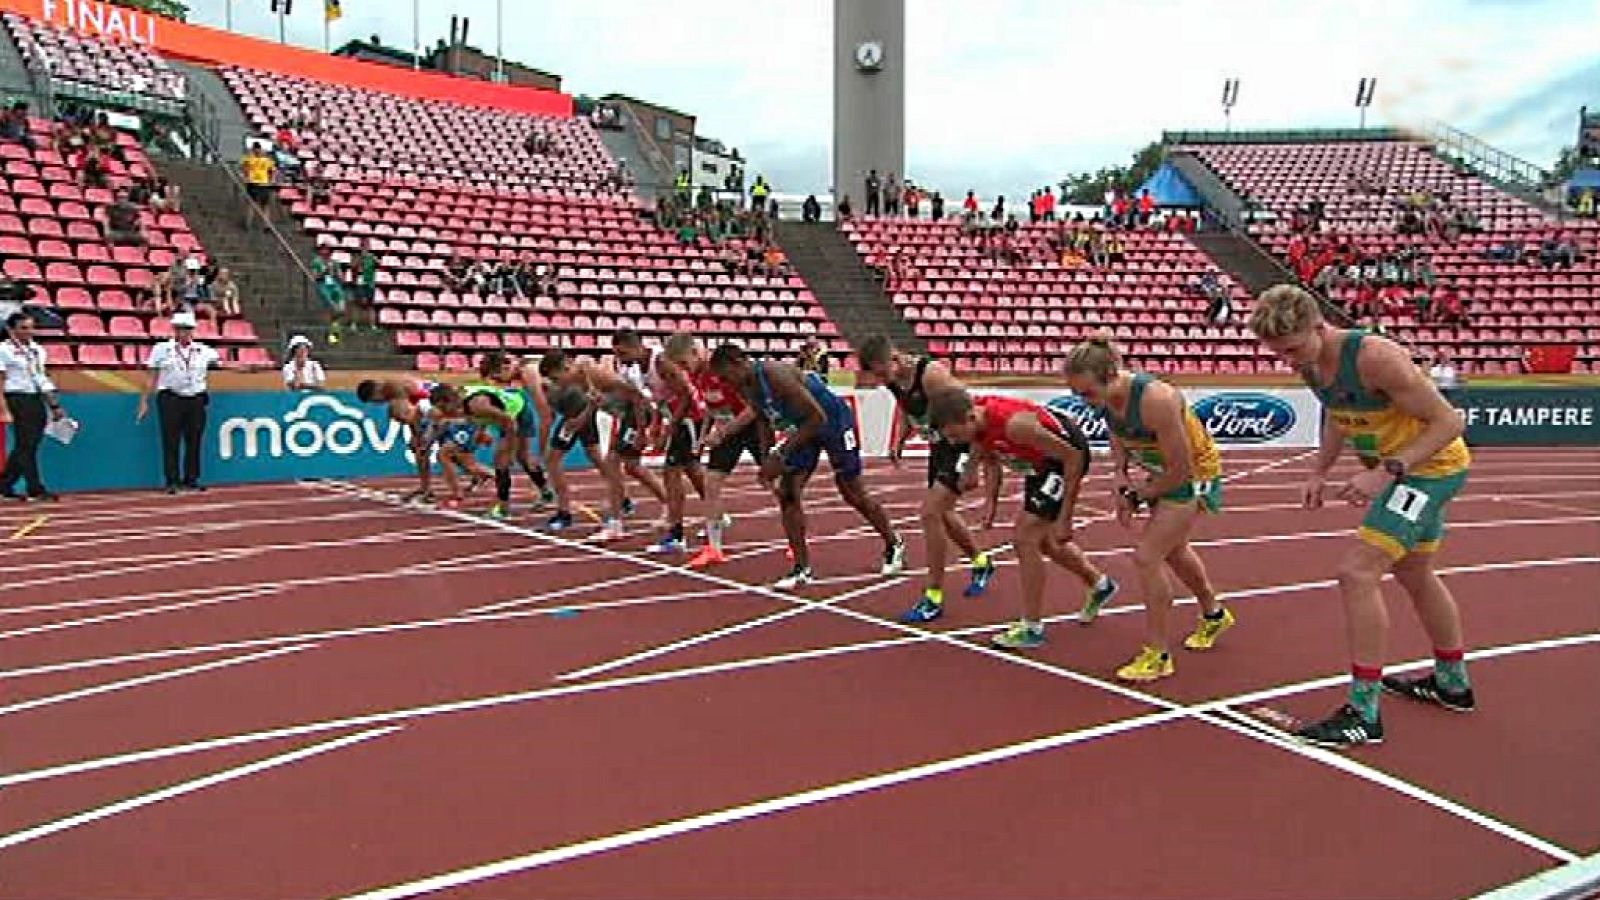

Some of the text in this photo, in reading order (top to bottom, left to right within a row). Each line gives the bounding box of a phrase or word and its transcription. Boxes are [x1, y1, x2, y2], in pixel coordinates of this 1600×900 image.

[1206, 401, 1276, 436] Ford
[1485, 407, 1593, 426] TAMPERE
[1401, 491, 1417, 512] 1
